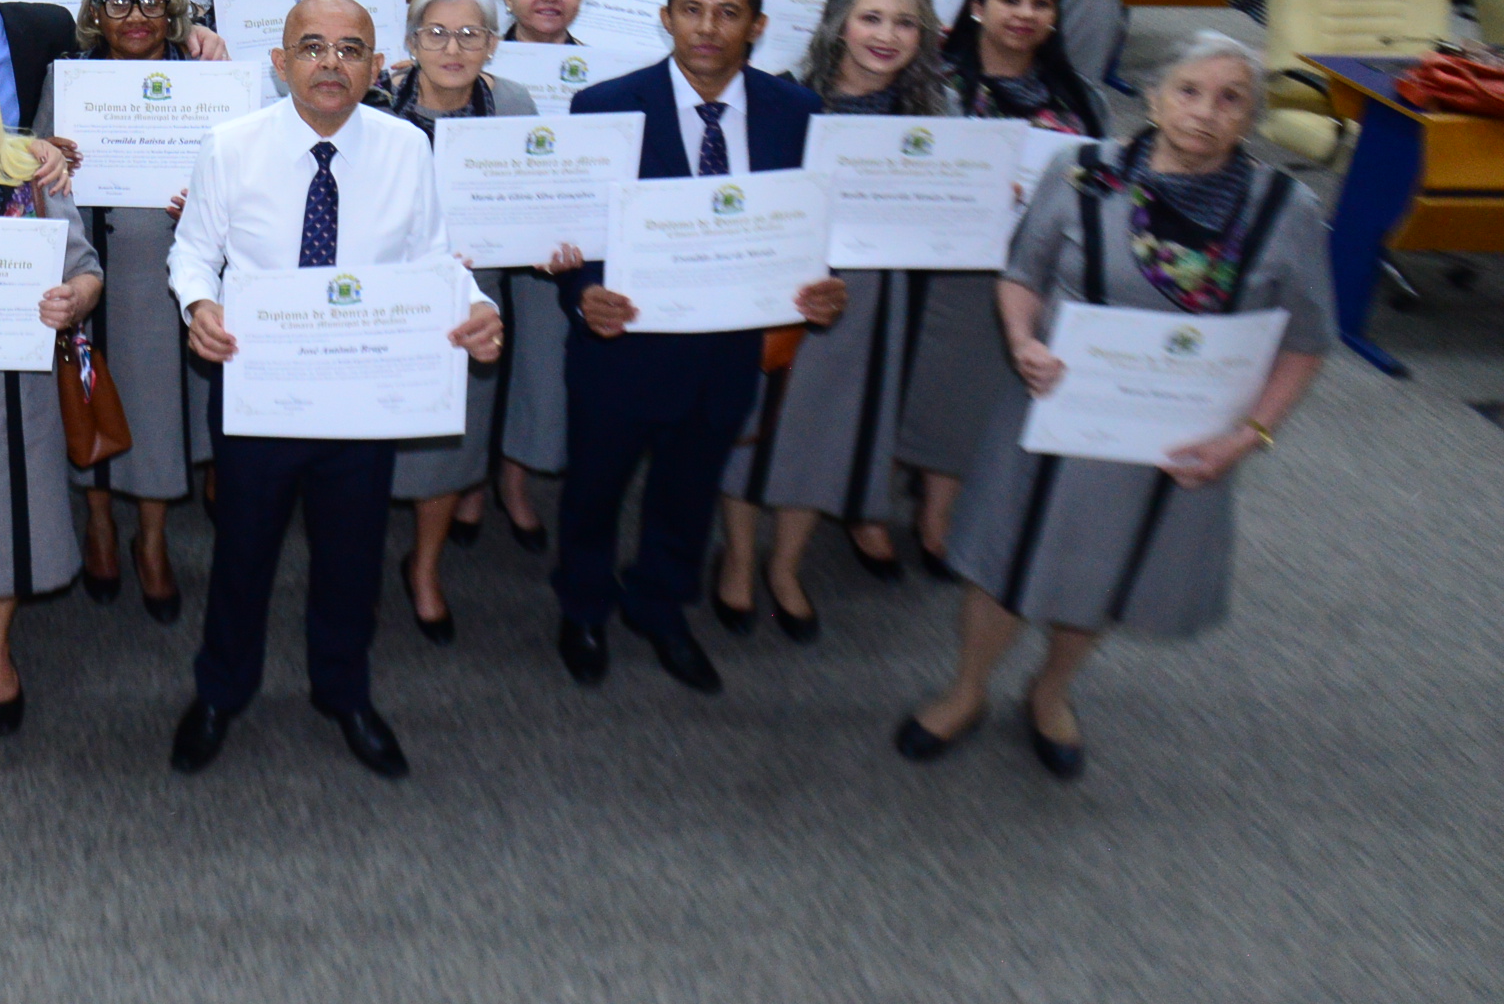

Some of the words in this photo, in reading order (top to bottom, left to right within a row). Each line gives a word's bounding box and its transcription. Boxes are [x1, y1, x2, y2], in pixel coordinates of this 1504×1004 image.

[244, 18, 283, 28] Diploma
[84, 102, 126, 113] Diploma
[130, 104, 140, 112] de
[145, 103, 177, 113] Honra
[195, 103, 230, 113] Mérito
[134, 114, 170, 122] Municipal
[101, 137, 136, 145] Cremilda
[257, 310, 309, 322] Diploma
[313, 310, 325, 319] de
[330, 308, 368, 320] Honra
[372, 308, 385, 317] ao
[390, 304, 431, 316] Mérito
